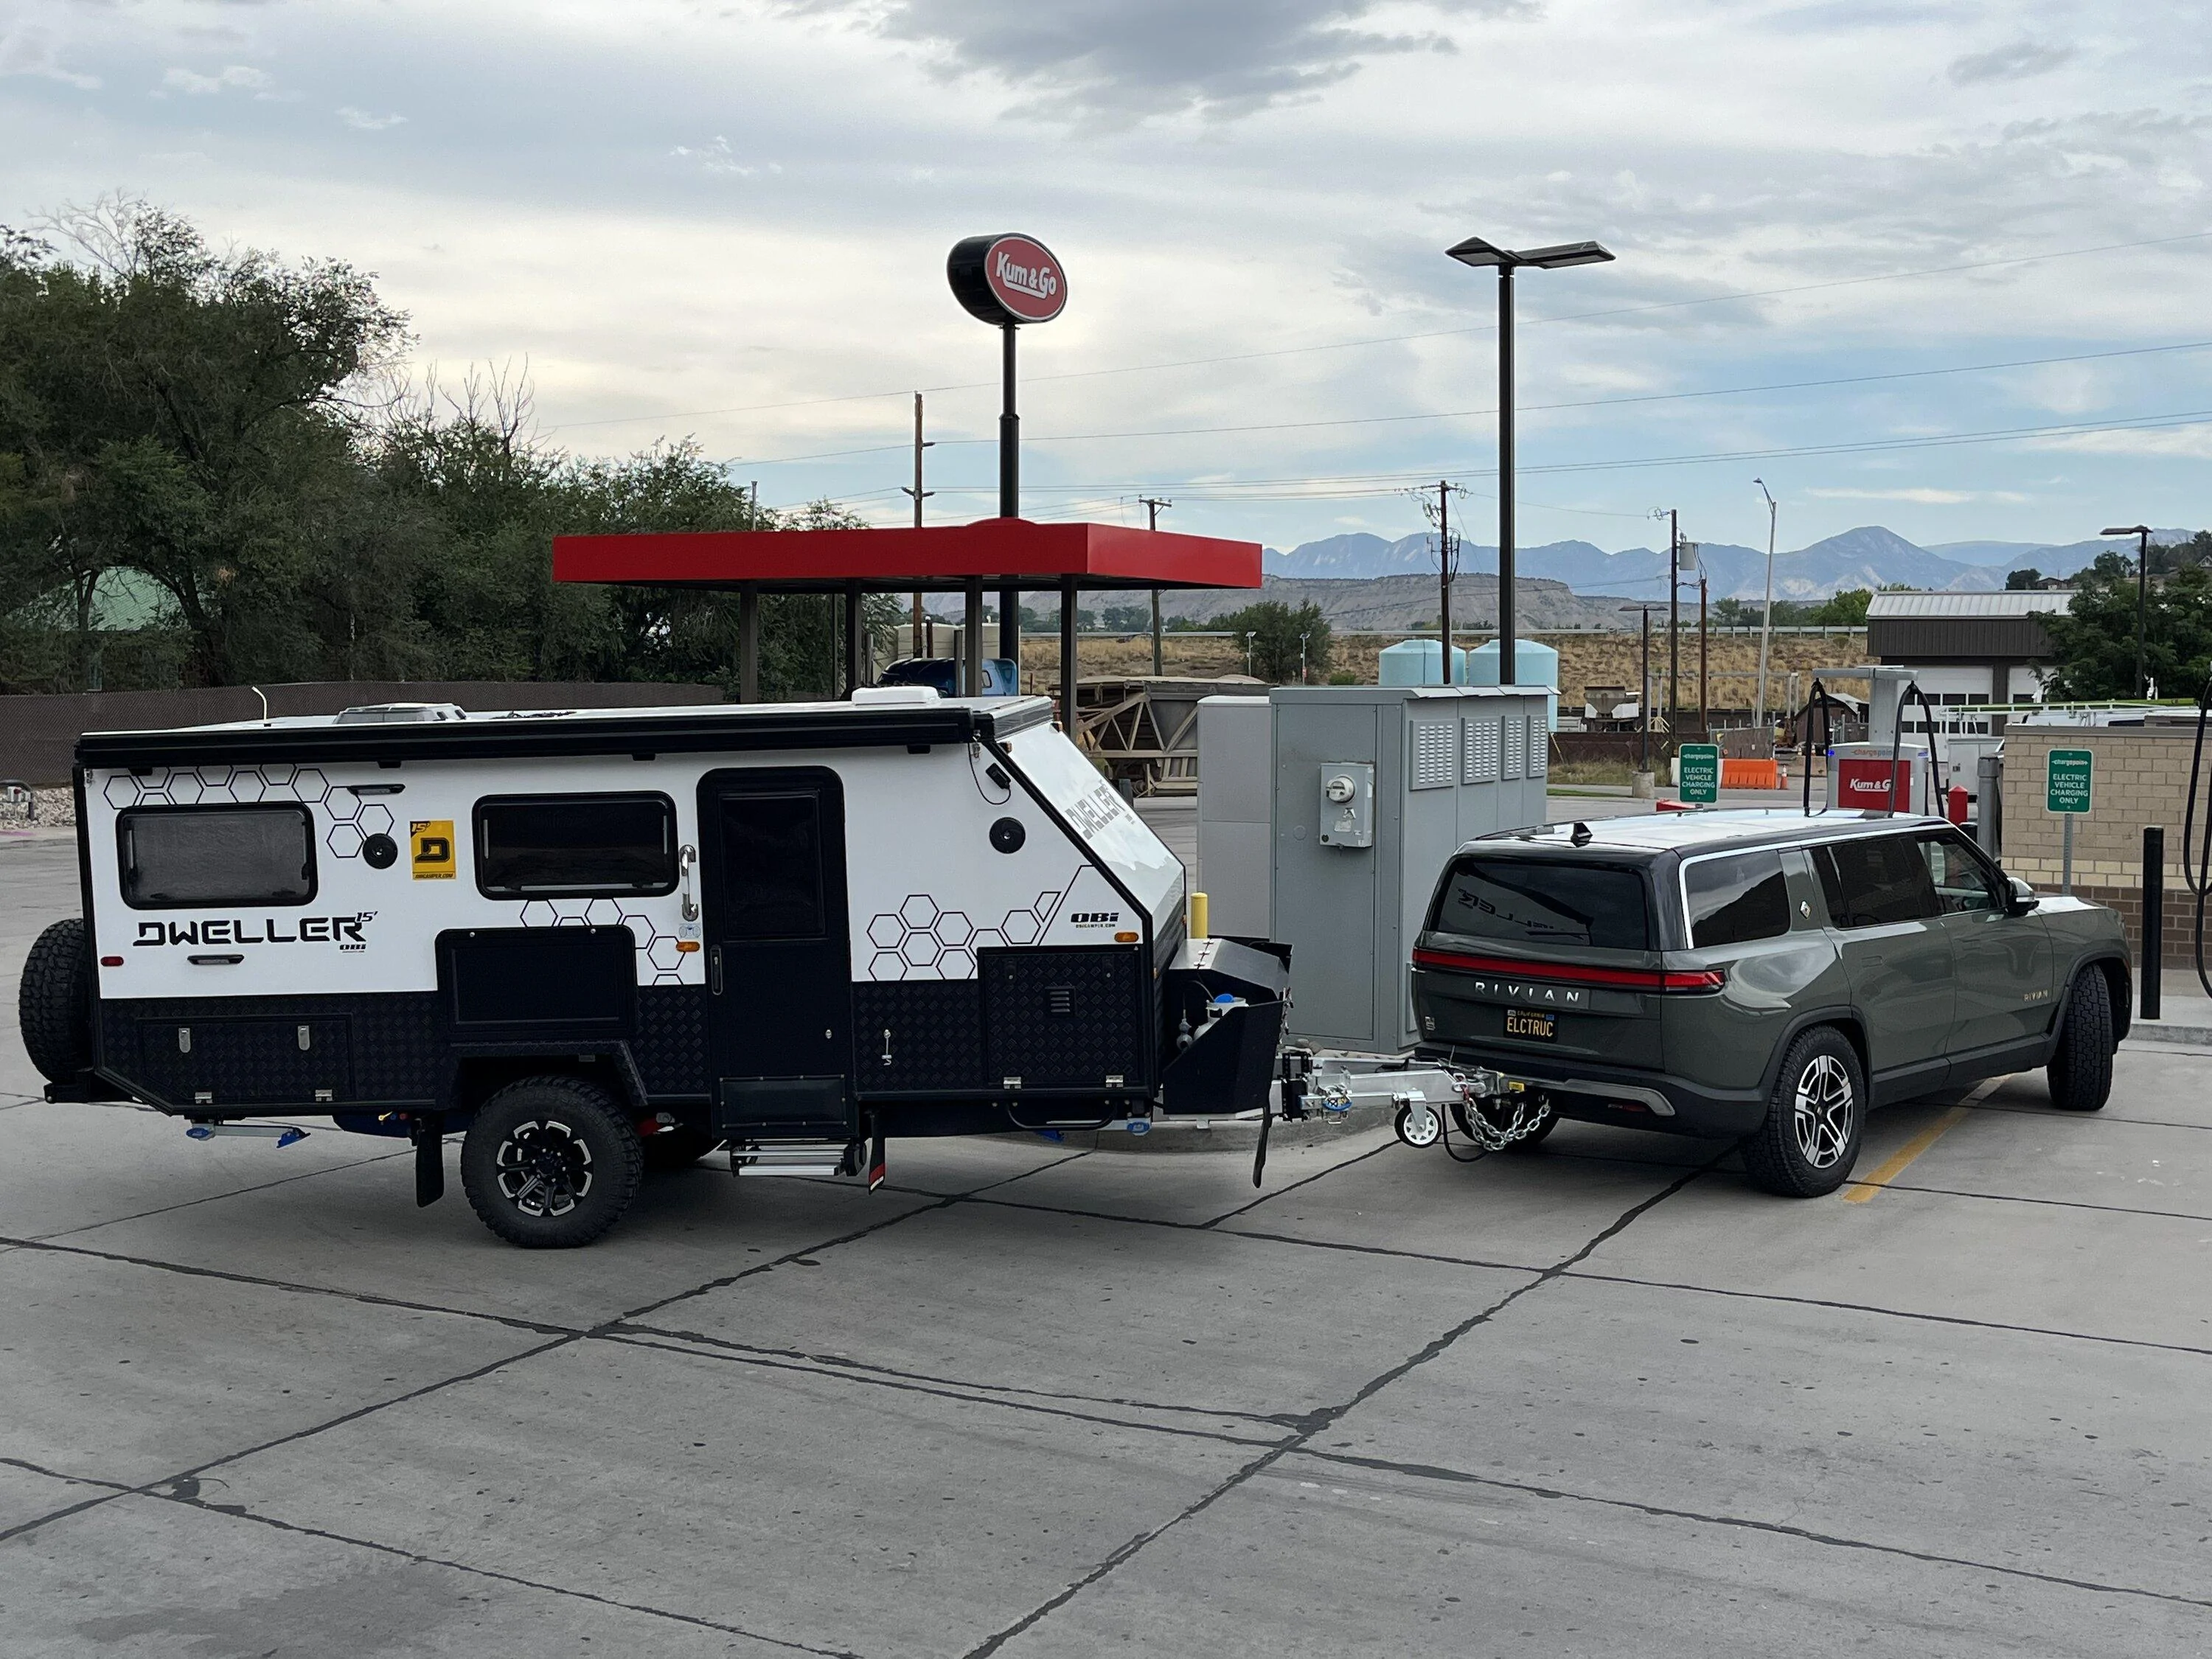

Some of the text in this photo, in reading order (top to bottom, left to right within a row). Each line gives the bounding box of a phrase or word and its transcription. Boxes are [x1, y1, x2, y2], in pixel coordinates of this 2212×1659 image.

[996, 251, 1028, 286] Kum
[1039, 267, 1057, 299] Go
[1851, 748, 1893, 757] chargepoin
[1849, 779, 1891, 792] Kum & G
[2052, 773, 2087, 782] ELECTRIC
[2050, 789, 2089, 797] CHARGING
[414, 837, 451, 864] D
[133, 917, 366, 946] DWELLER
[1475, 981, 1579, 1002] RIVIAN
[1506, 1017, 1554, 1037] ELCTRUC
